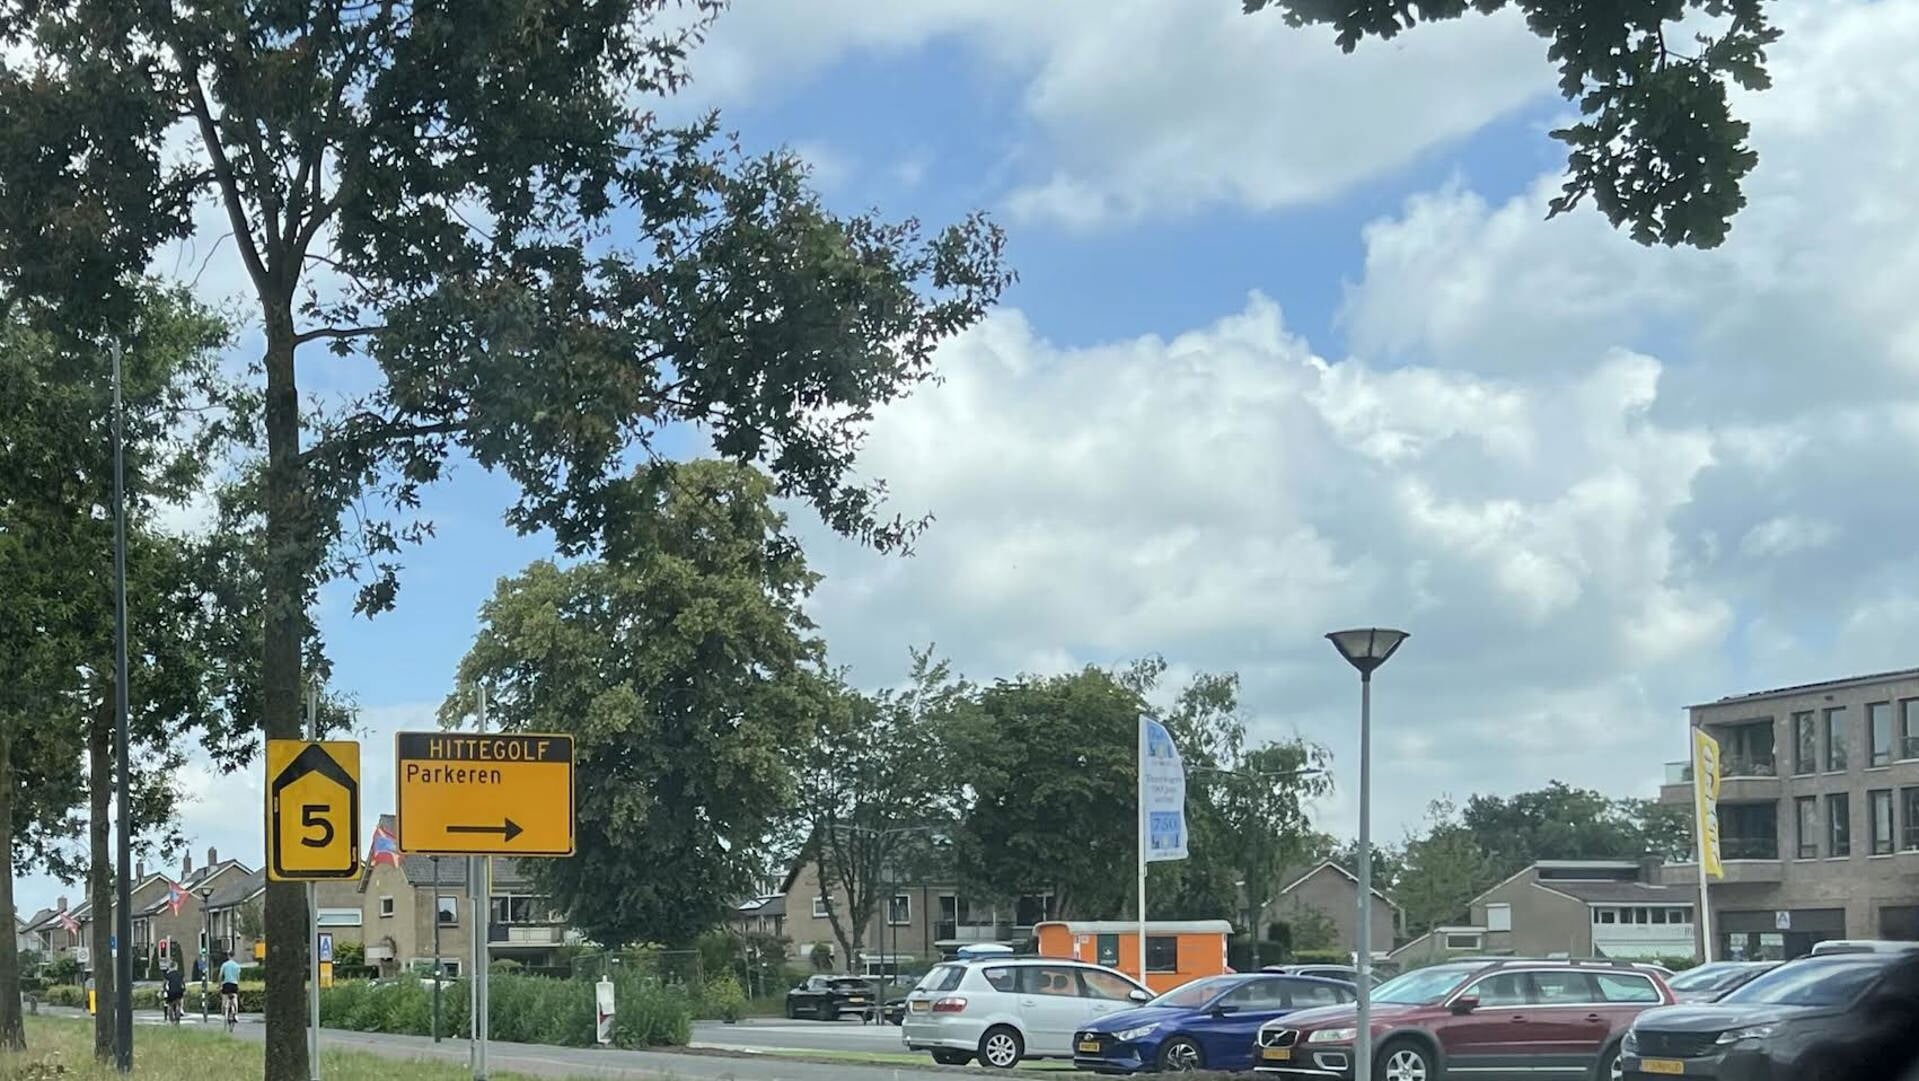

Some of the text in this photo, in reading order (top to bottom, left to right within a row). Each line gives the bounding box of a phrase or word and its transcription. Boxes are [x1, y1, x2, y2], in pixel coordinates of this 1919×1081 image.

[430, 740, 550, 761] HITTEGOLF
[407, 764, 501, 784] Parkeren
[301, 804, 334, 848] 5
